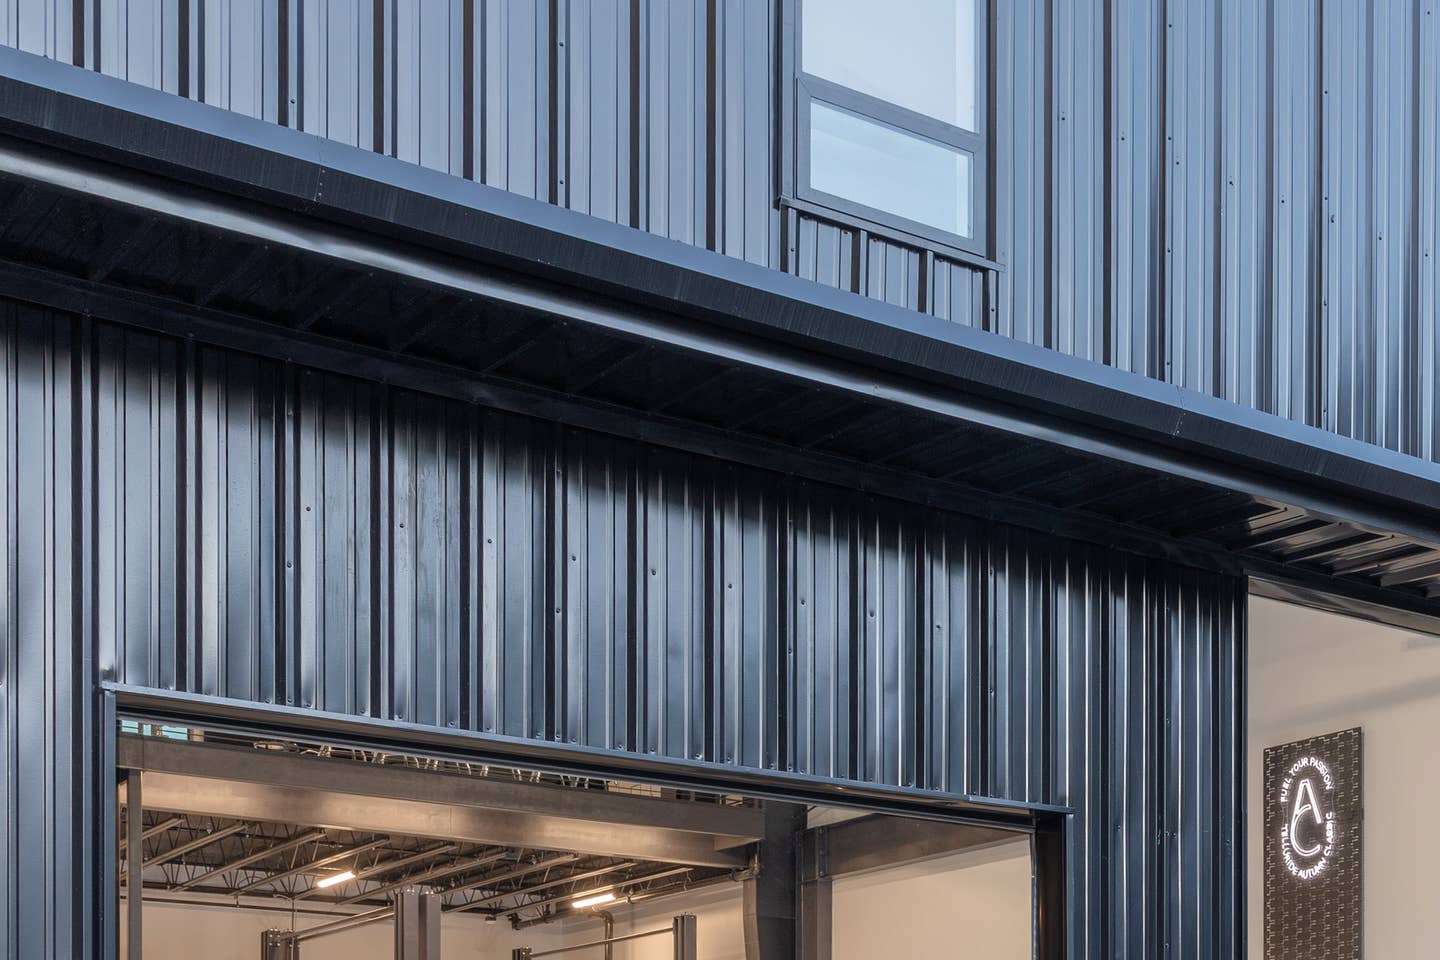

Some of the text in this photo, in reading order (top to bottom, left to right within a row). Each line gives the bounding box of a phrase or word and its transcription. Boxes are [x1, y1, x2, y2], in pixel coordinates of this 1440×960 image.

[1280, 756, 1333, 803] FUEL YOUR PASSION
[1297, 857, 1327, 880] AUTUMN
